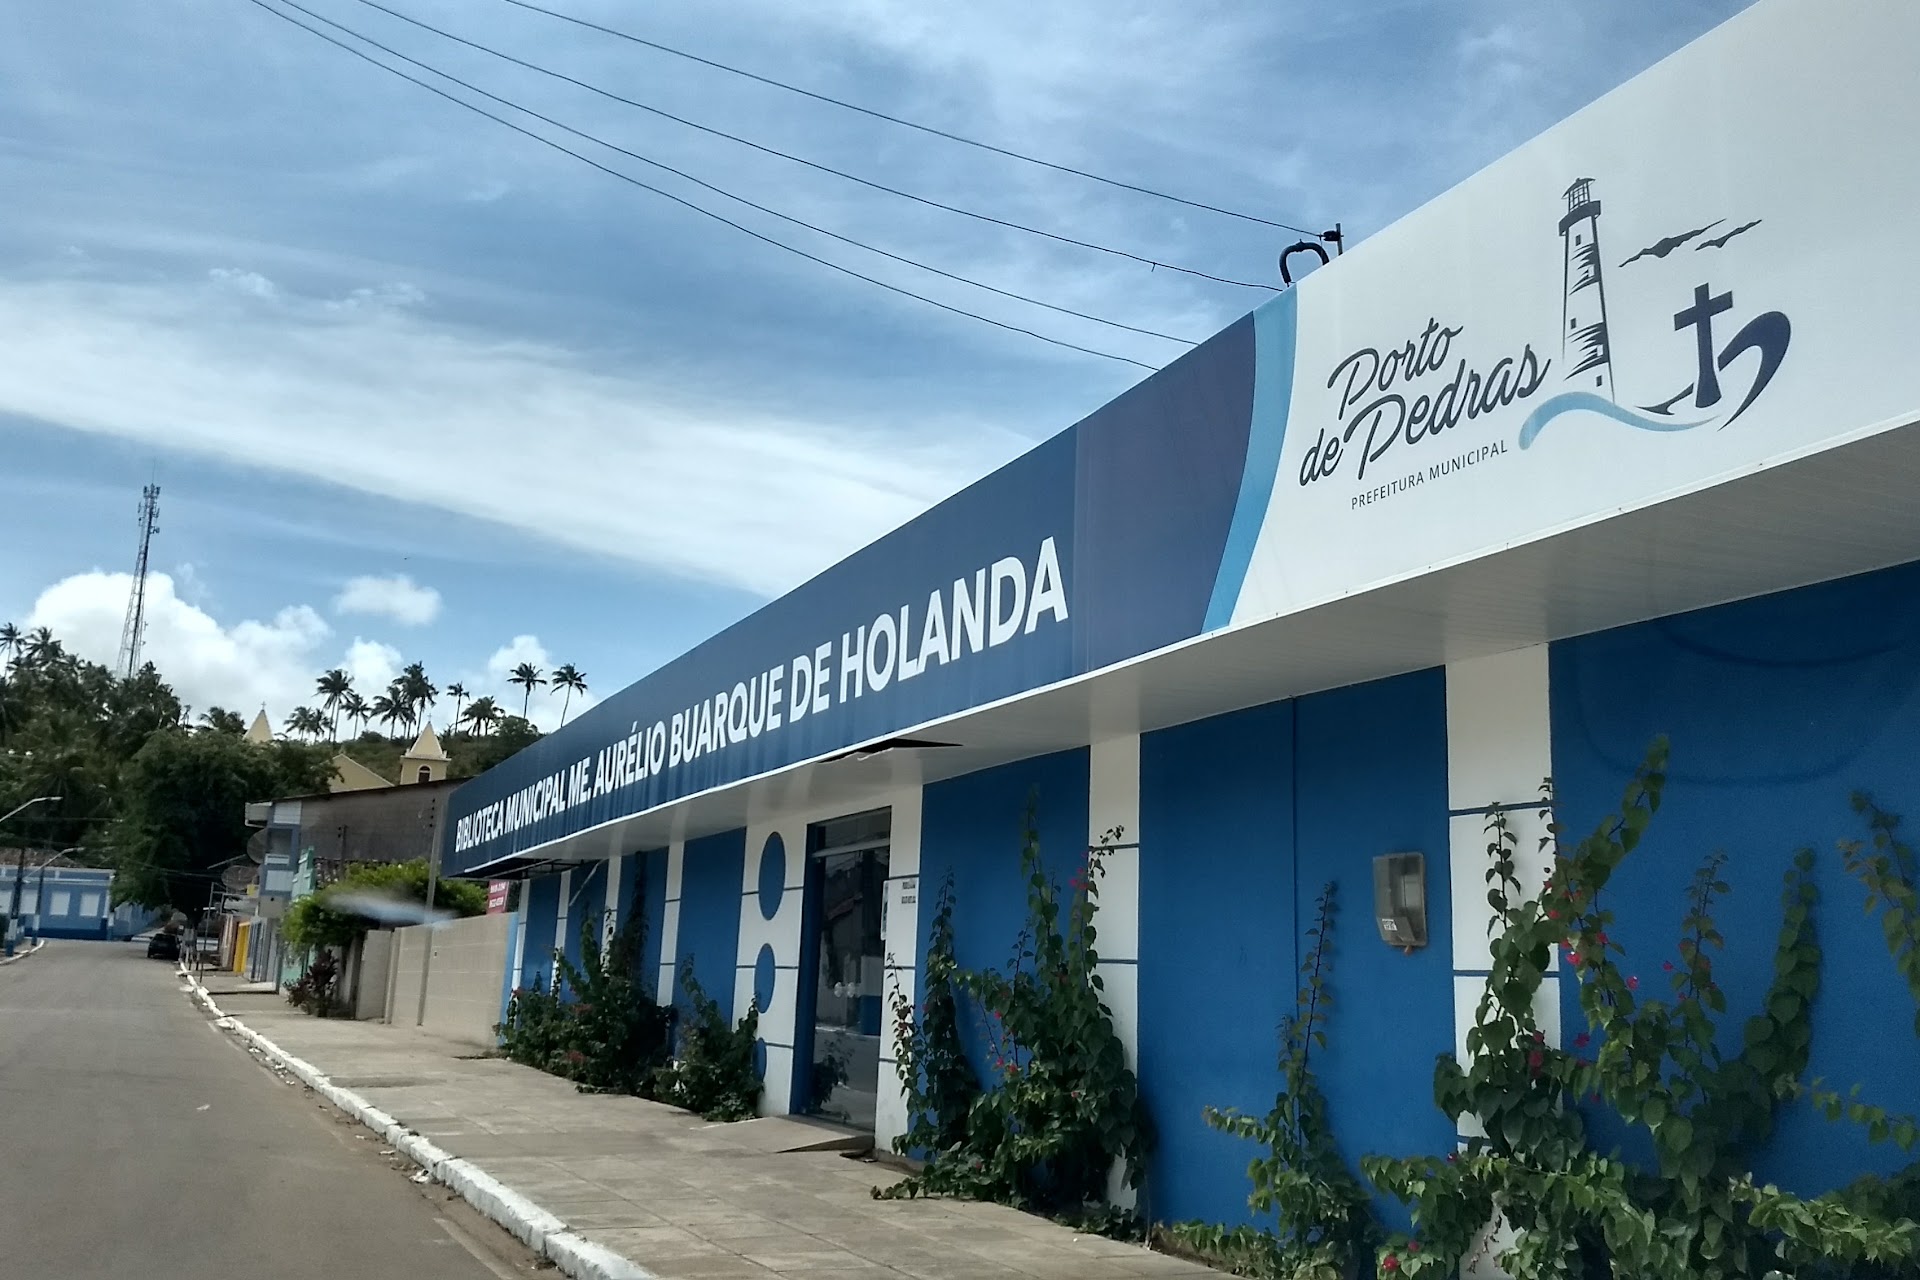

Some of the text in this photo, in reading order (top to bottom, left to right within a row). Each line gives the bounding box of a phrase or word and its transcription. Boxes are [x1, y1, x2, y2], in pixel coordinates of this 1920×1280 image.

[1299, 343, 1552, 487] de Pedras
[1327, 317, 1464, 420] Porto
[1351, 440, 1508, 510] PREFEITURA MUNICIPAL
[455, 799, 504, 853] BIBLIOTECA
[504, 769, 566, 834] MUNICIPAL
[592, 721, 666, 798] AURÉLIO
[669, 665, 784, 768] BUARQUE
[789, 641, 832, 723] DE
[839, 536, 1069, 704] HOLANDA
